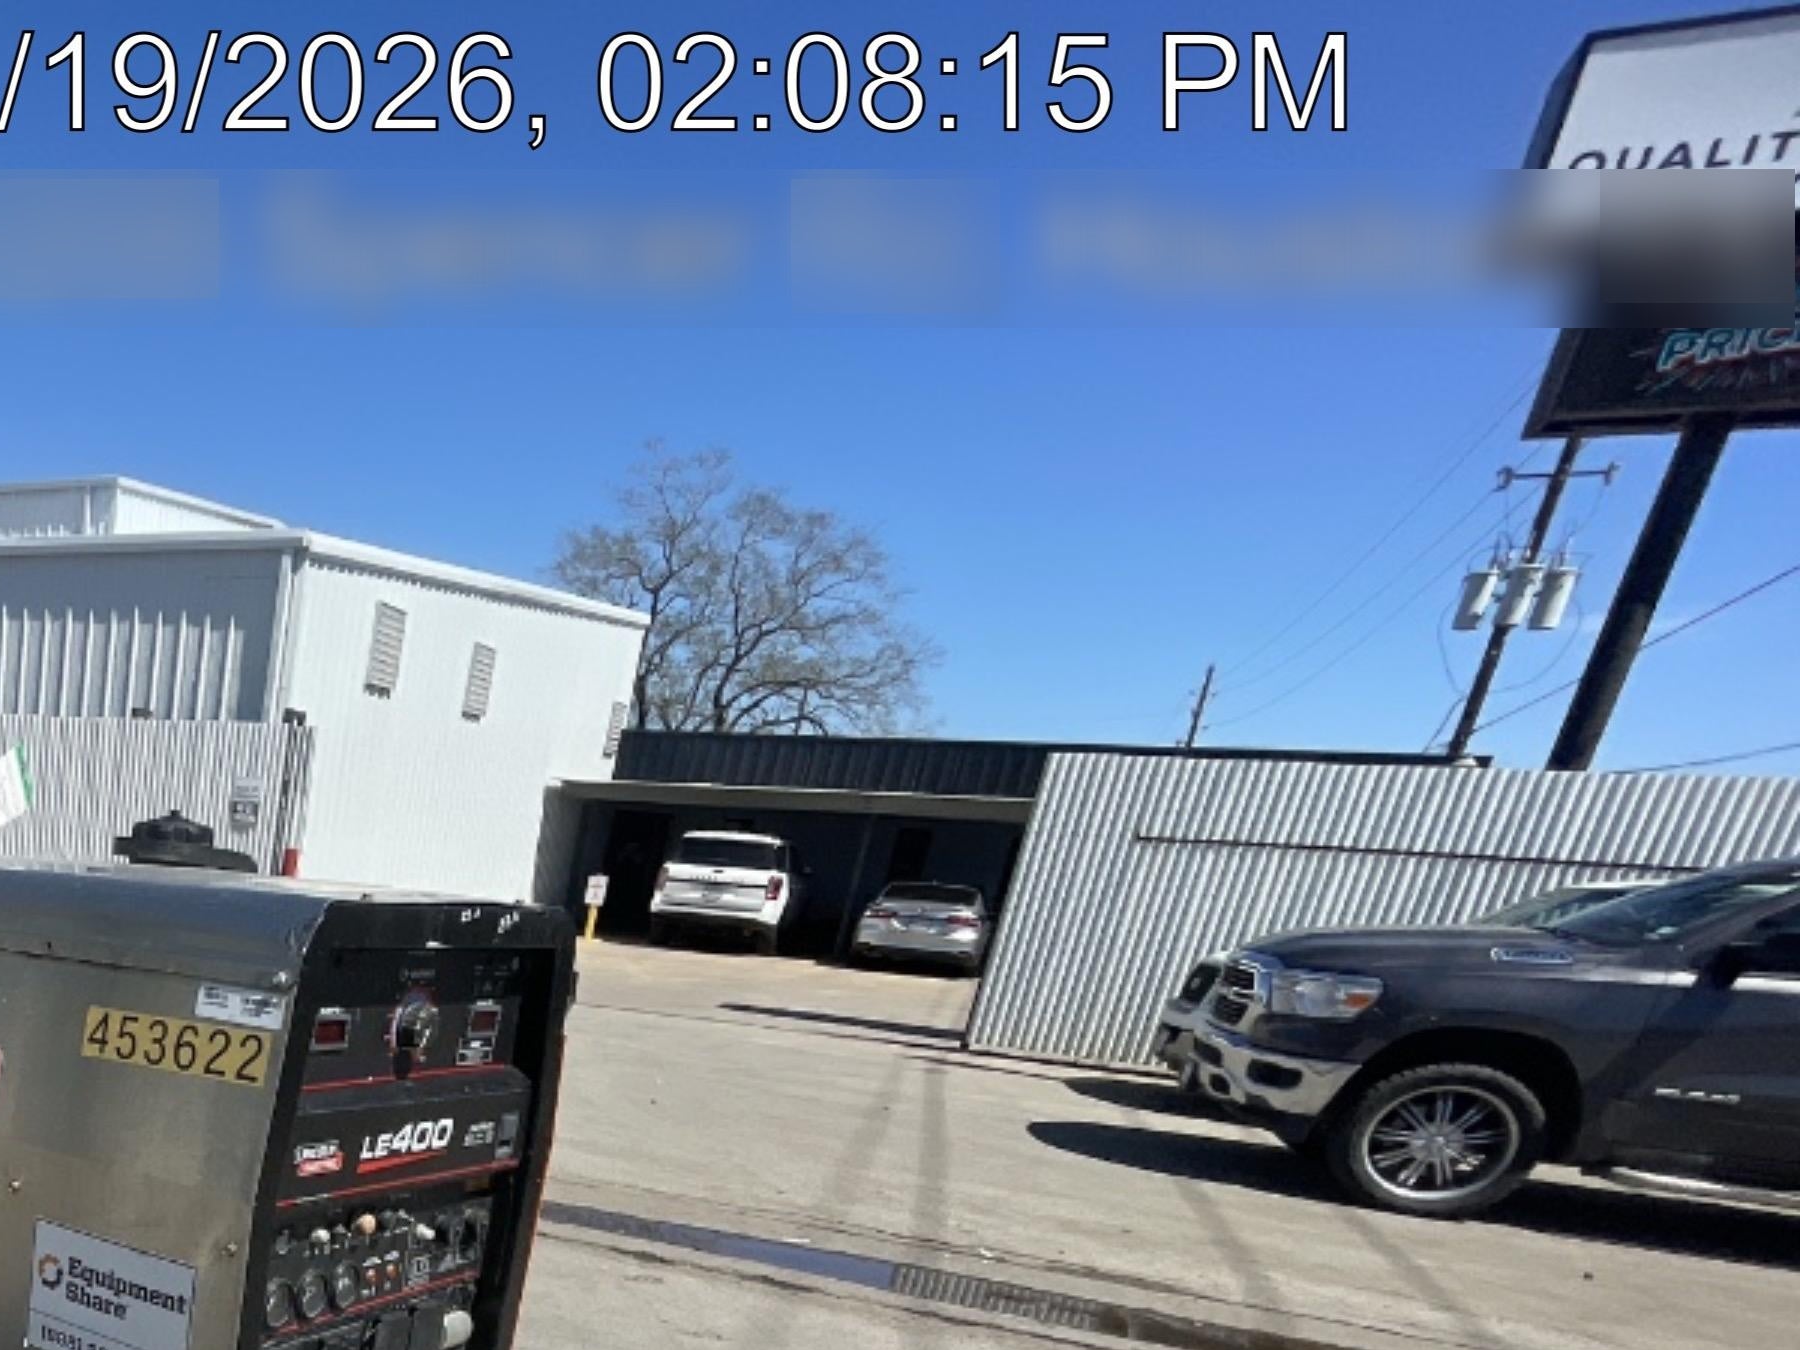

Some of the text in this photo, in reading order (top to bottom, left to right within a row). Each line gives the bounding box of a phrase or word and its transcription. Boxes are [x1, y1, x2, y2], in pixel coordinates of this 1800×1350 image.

[86, 1010, 264, 1084] 453622
[358, 1117, 455, 1161] LE400
[65, 1280, 128, 1321] Share
[67, 1255, 187, 1315] Equipment
